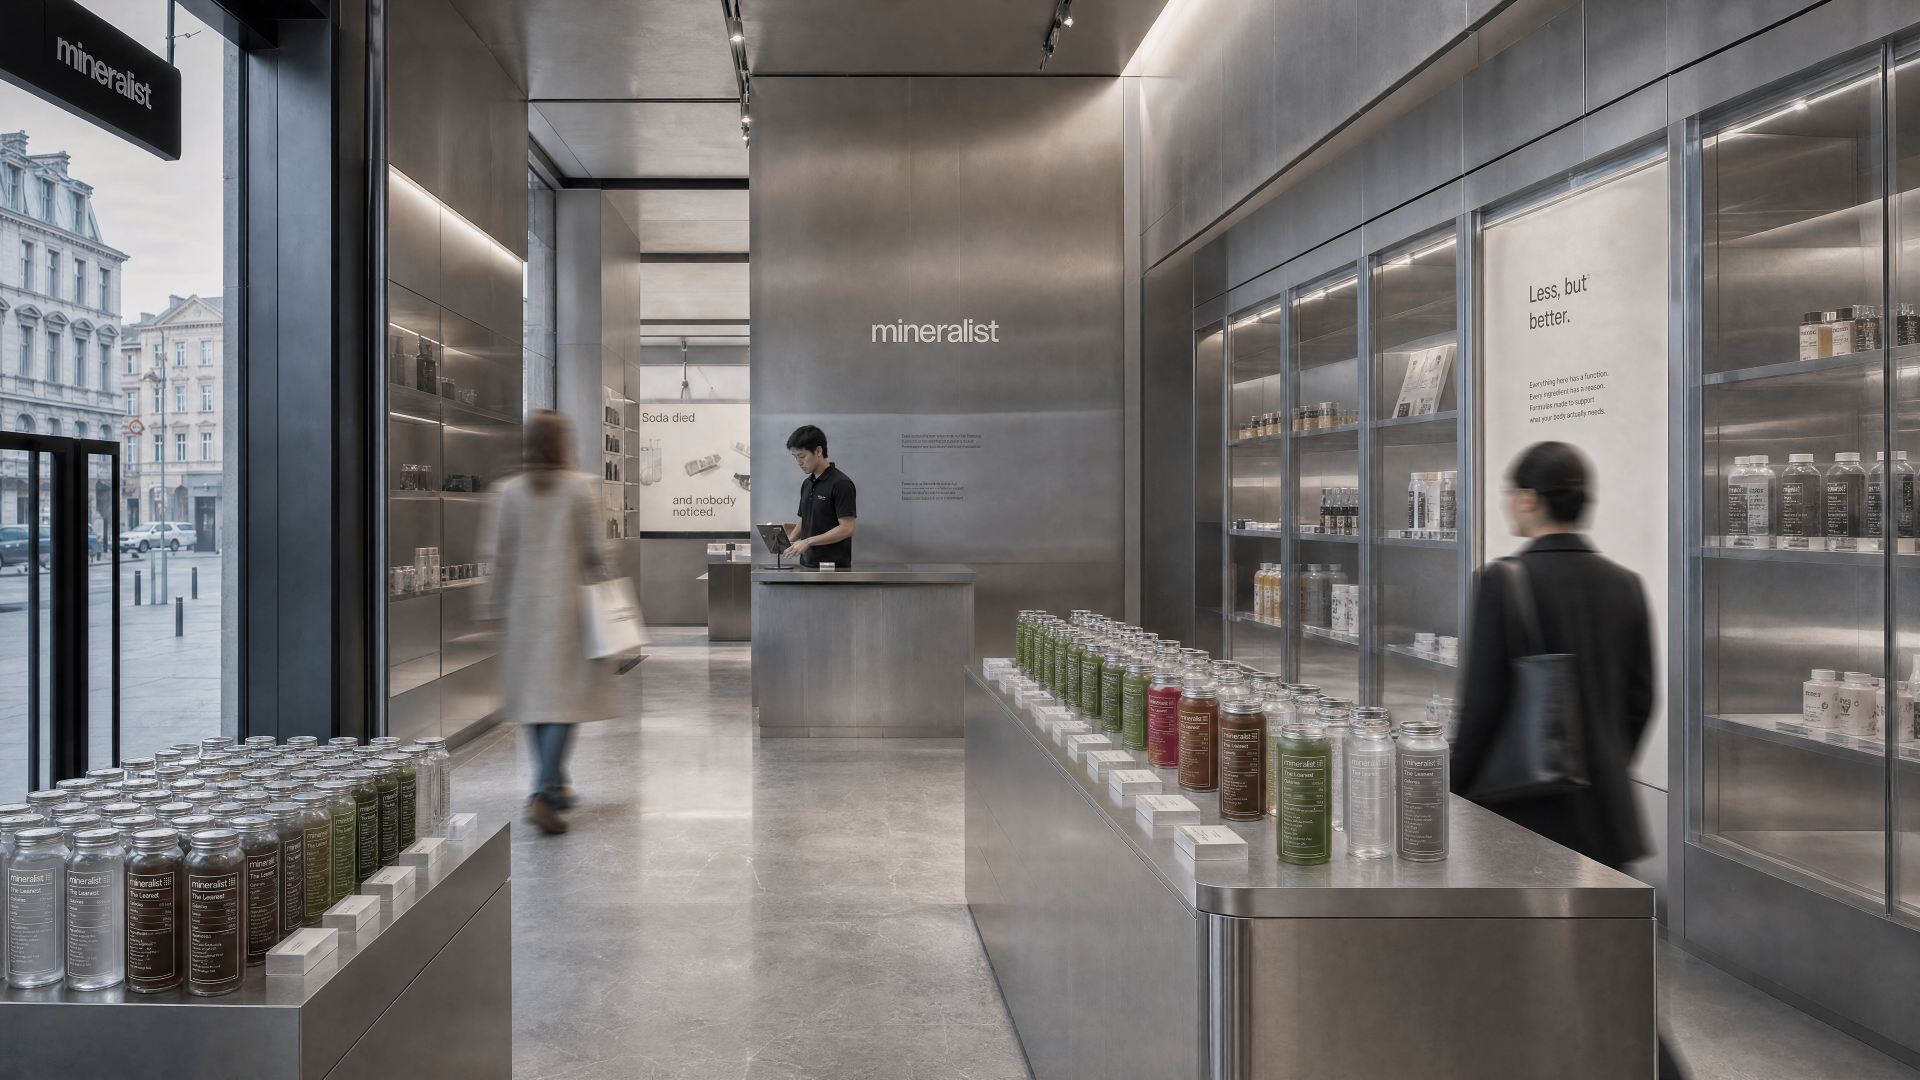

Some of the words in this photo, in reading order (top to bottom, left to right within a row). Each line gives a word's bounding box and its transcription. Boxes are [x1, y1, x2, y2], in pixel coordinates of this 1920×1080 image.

[57, 36, 152, 110] mineralist
[1529, 284, 1561, 303] Less,
[1564, 274, 1588, 296] but
[1529, 309, 1570, 330] better.
[871, 318, 1000, 343] mineralist
[1529, 378, 1556, 389] Everything
[1556, 377, 1569, 385] here
[1584, 370, 1609, 380] function.
[1529, 393, 1543, 401] Every
[1543, 387, 1569, 399] ingredient
[1584, 383, 1606, 392] reason.
[1553, 400, 1568, 409] made
[1574, 396, 1595, 406] support
[642, 412, 669, 423] Soda
[672, 412, 695, 423] died
[1541, 415, 1553, 424] your
[1553, 412, 1566, 421] body
[1566, 409, 1587, 418] actually
[1587, 407, 1606, 416] needs.
[672, 495, 692, 505] and
[696, 495, 737, 508] nobody
[672, 506, 716, 517] noticed.
[1284, 759, 1316, 768] mineralist
[1403, 758, 1436, 767] mineralist
[10, 874, 45, 883] mineralist
[69, 876, 102, 885] mineralist
[129, 878, 163, 888] mineralist
[191, 879, 228, 889] mineralist
